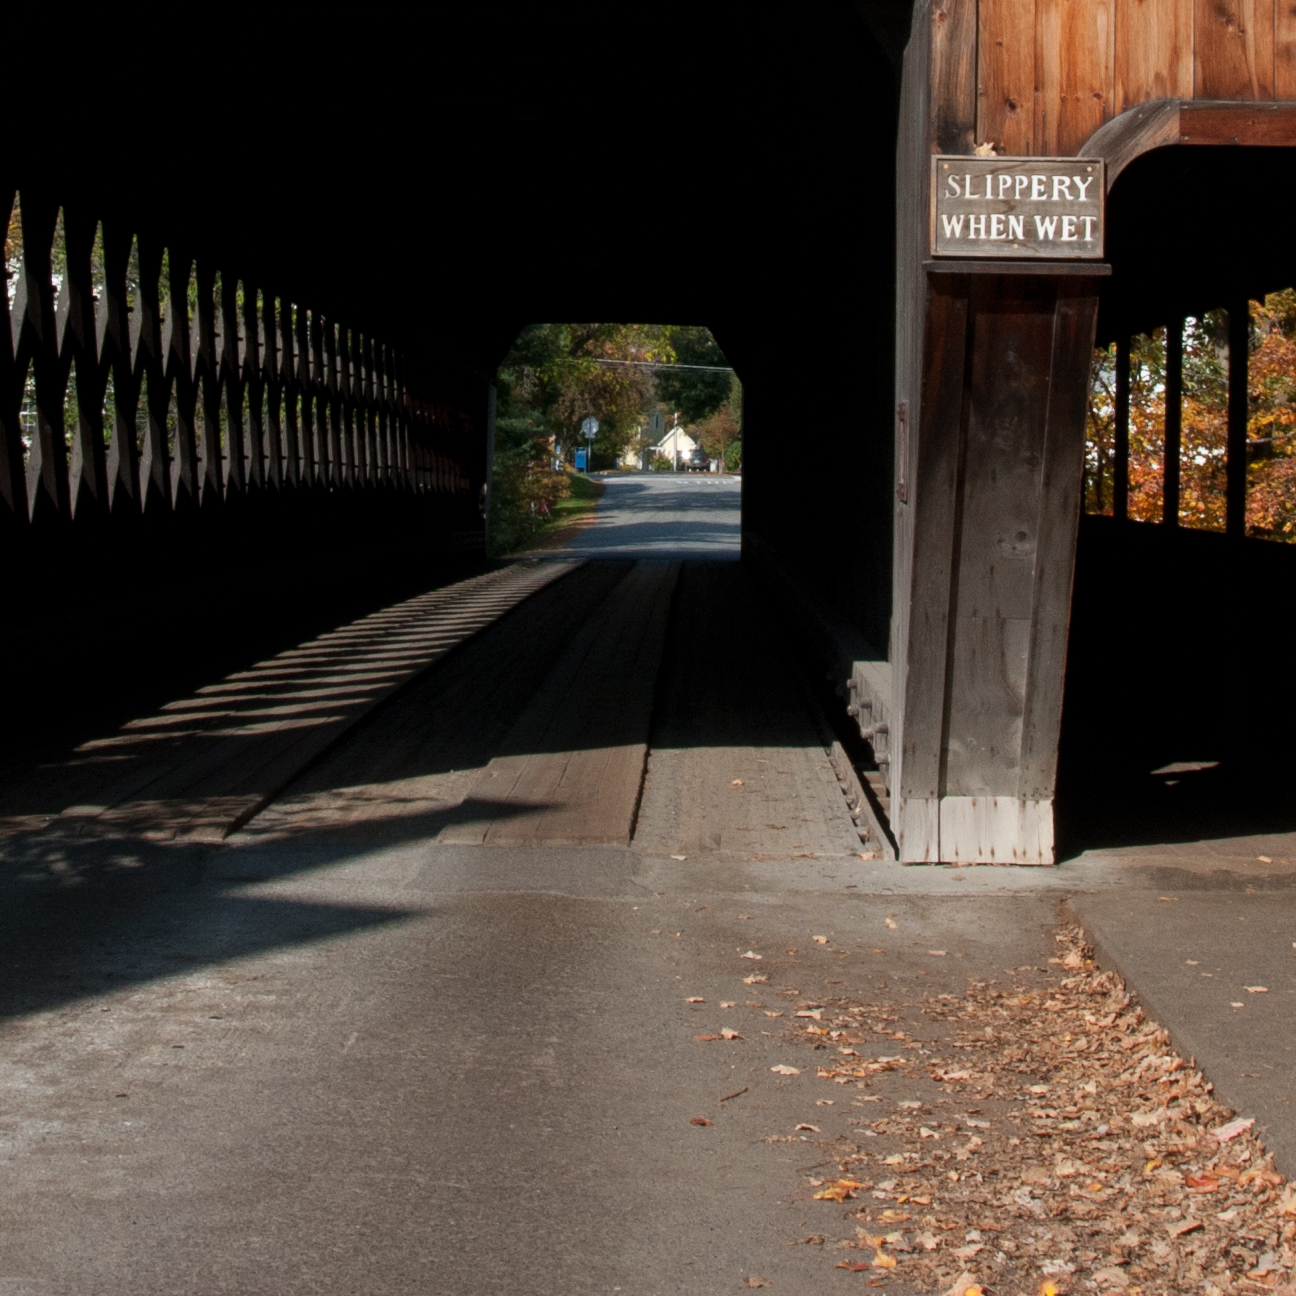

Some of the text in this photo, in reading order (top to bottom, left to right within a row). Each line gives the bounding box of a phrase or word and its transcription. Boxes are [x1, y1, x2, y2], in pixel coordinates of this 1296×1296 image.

[945, 174, 1093, 201] SLIPPERY
[941, 214, 1097, 242] WHEN WET
